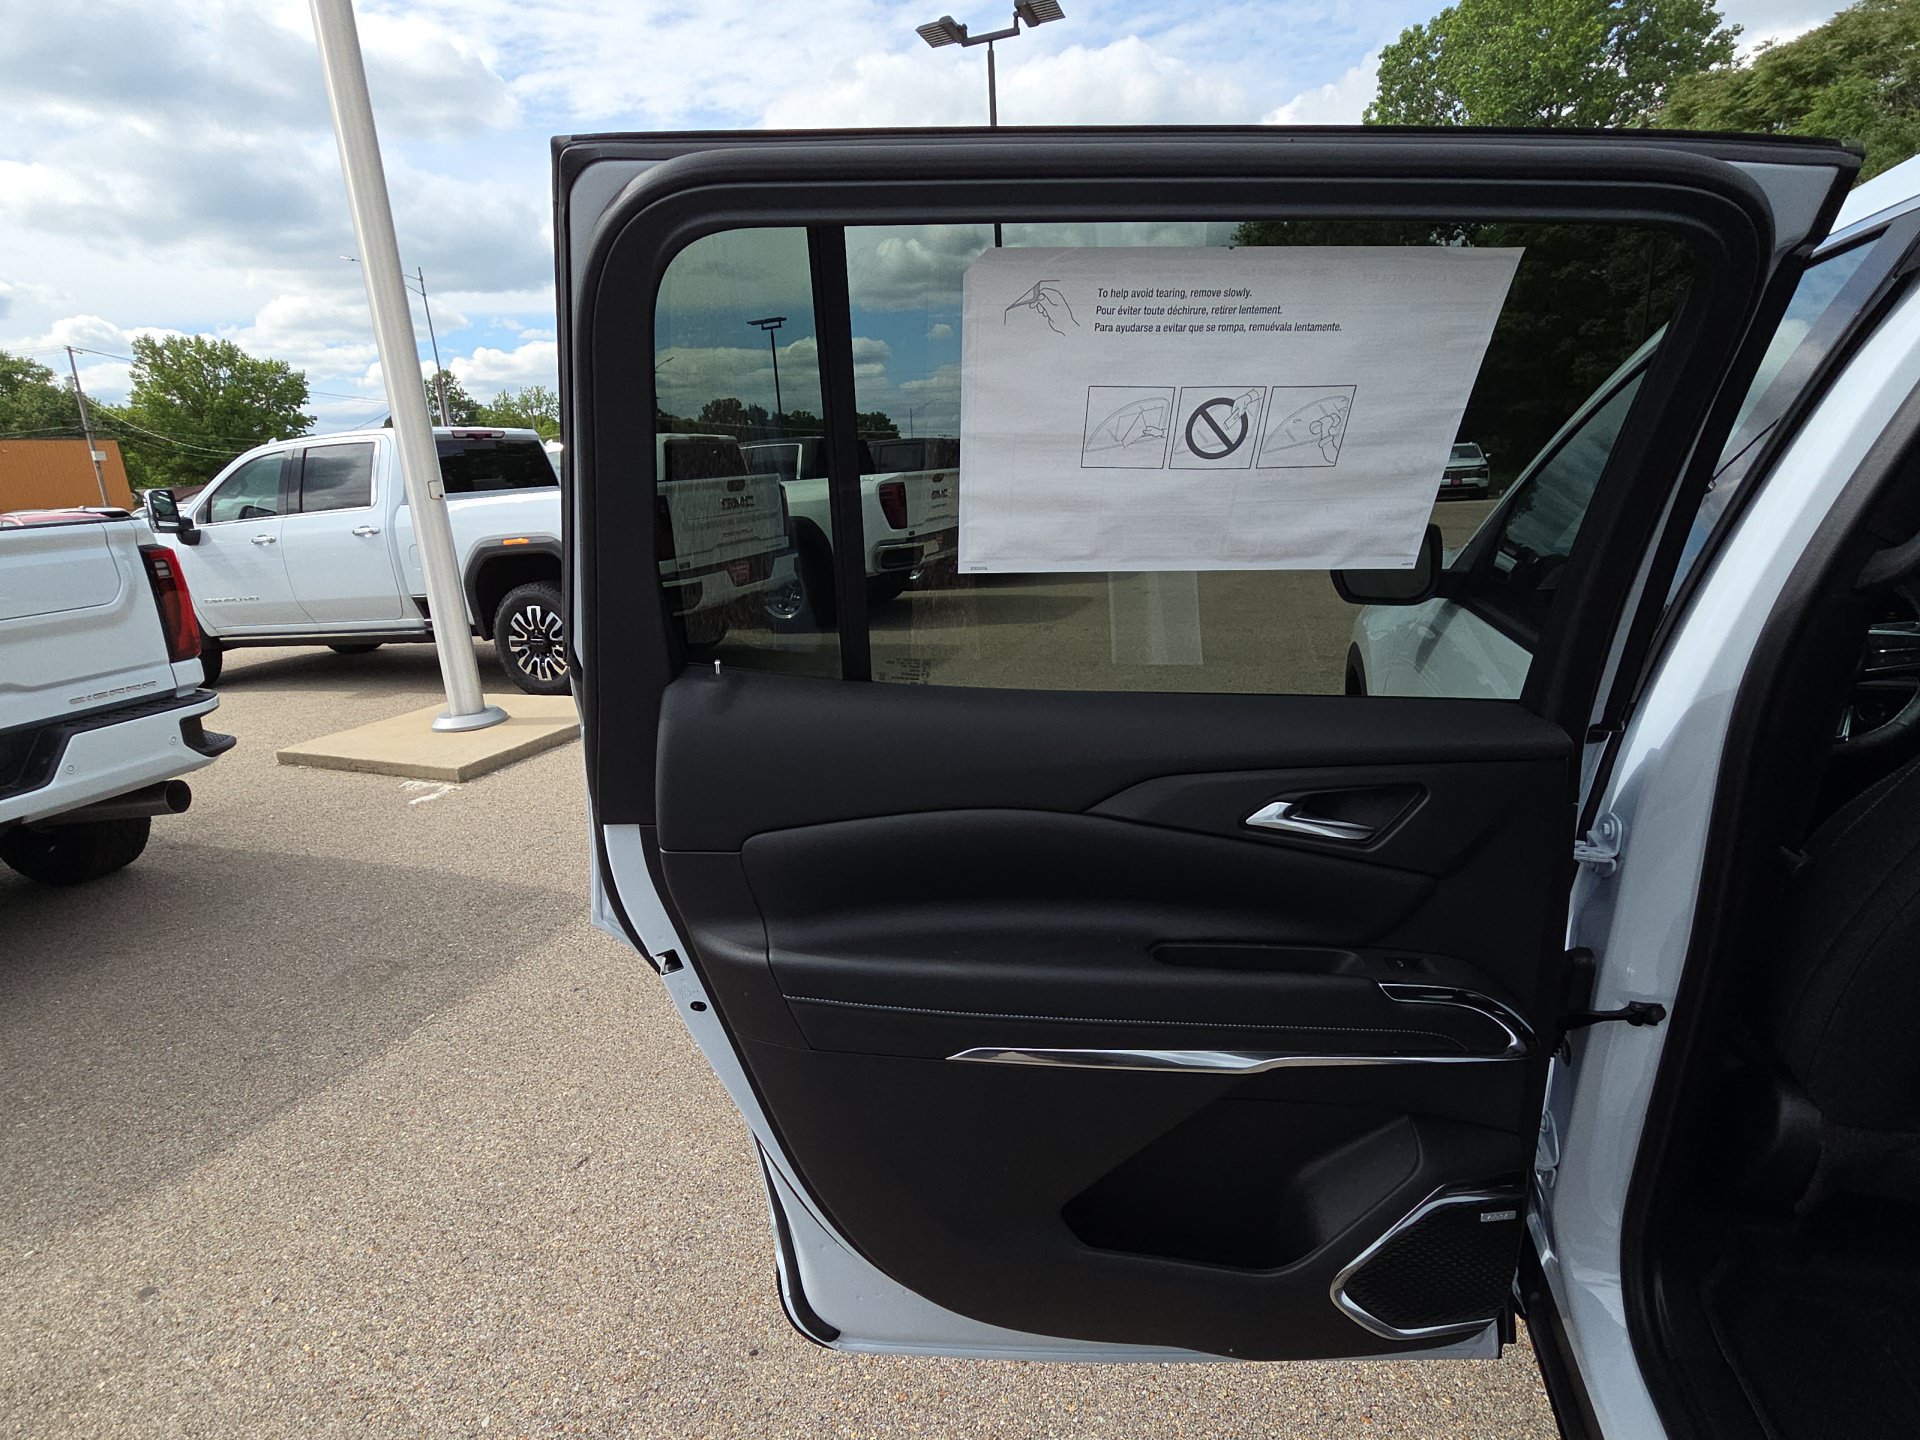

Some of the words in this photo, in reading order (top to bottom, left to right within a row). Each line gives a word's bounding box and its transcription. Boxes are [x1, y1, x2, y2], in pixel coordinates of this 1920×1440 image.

[1098, 288, 1108, 298] To
[1110, 288, 1129, 300] help
[1130, 288, 1154, 298] avoid
[1156, 288, 1187, 300] tearing,
[1190, 289, 1222, 298] remove
[1223, 287, 1252, 299] slowly.
[1095, 305, 1116, 315] Pour
[1117, 305, 1141, 315] éviter
[1143, 306, 1165, 315] toute
[1167, 305, 1208, 316] déchirure,
[1211, 305, 1237, 315] retirer
[1238, 305, 1283, 315] lentement.
[1094, 322, 1114, 332] Para
[1115, 322, 1154, 334] ayudarse
[1155, 324, 1161, 332] a
[1163, 322, 1187, 332] evitar
[1188, 324, 1204, 334] que
[1205, 324, 1216, 332] se
[1217, 324, 1246, 334] rompa,
[1248, 321, 1293, 332] remuévala
[1294, 322, 1342, 332] lentamente.
[721, 495, 755, 509] GMC
